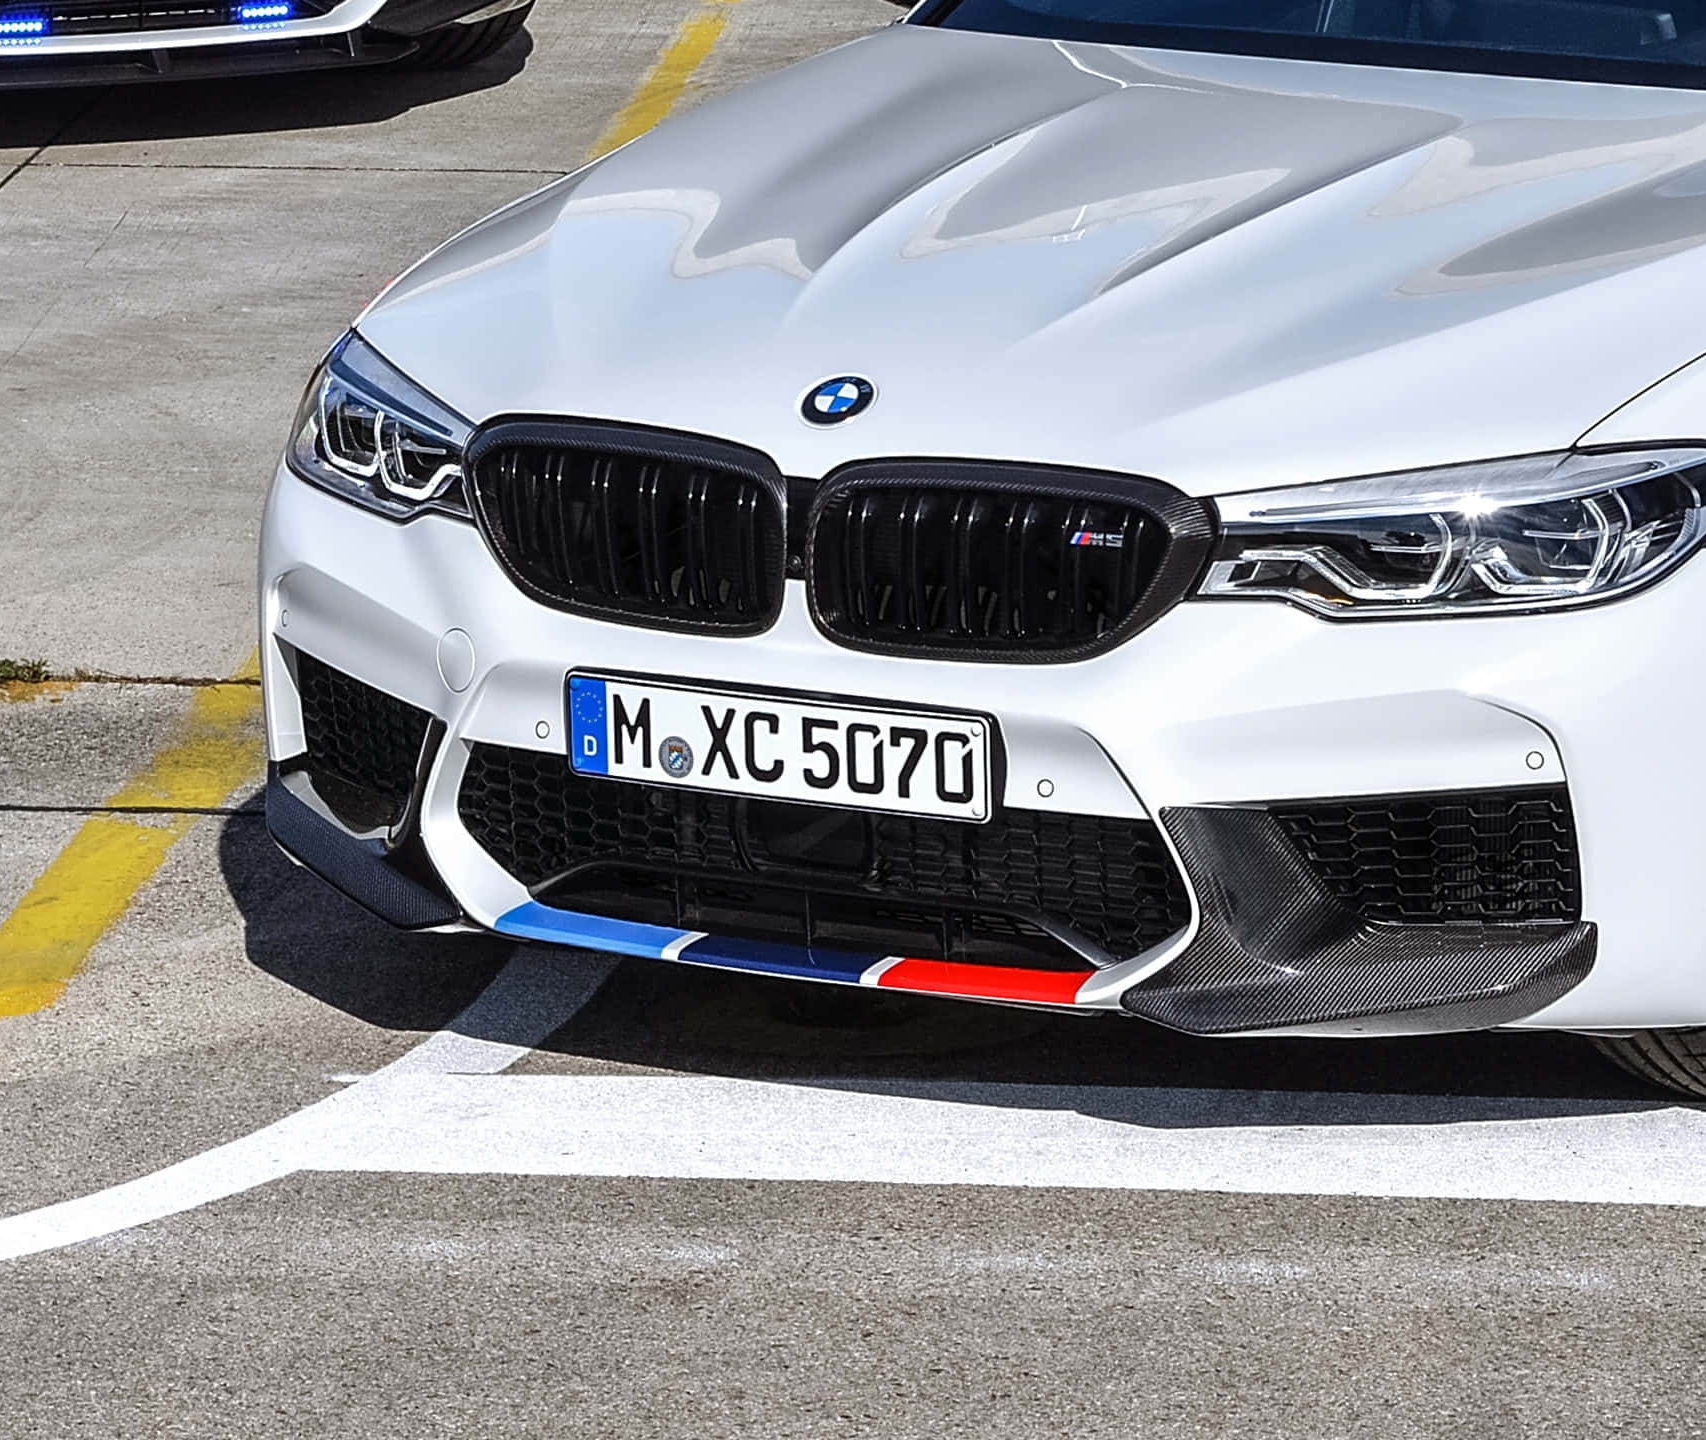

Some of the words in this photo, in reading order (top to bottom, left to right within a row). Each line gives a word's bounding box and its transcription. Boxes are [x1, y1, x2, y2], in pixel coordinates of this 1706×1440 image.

[582, 735, 597, 757] D
[612, 693, 653, 769] M
[700, 704, 785, 784] XC
[801, 716, 975, 804] 5070
